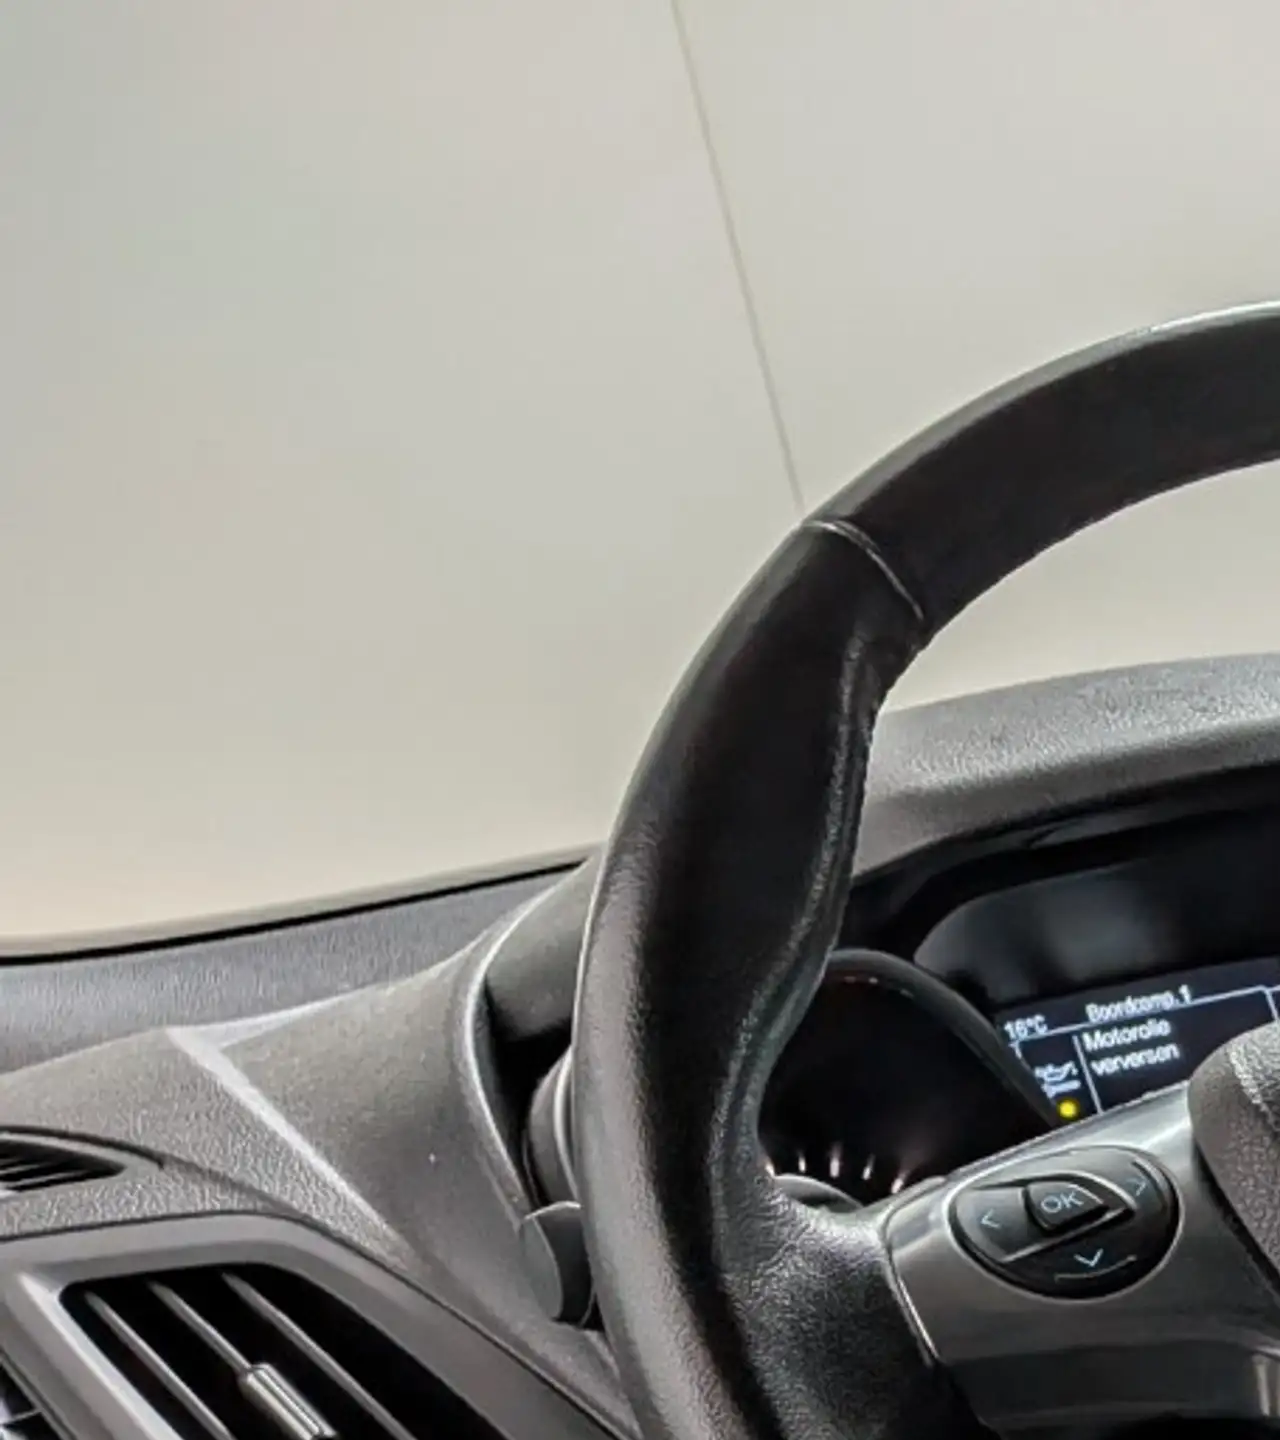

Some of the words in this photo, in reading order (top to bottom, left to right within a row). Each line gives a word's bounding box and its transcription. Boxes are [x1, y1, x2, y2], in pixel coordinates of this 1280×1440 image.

[1082, 1018, 1172, 1052] Motorolie
[1090, 1043, 1181, 1076] verversen
[1040, 1190, 1085, 1215] OK
